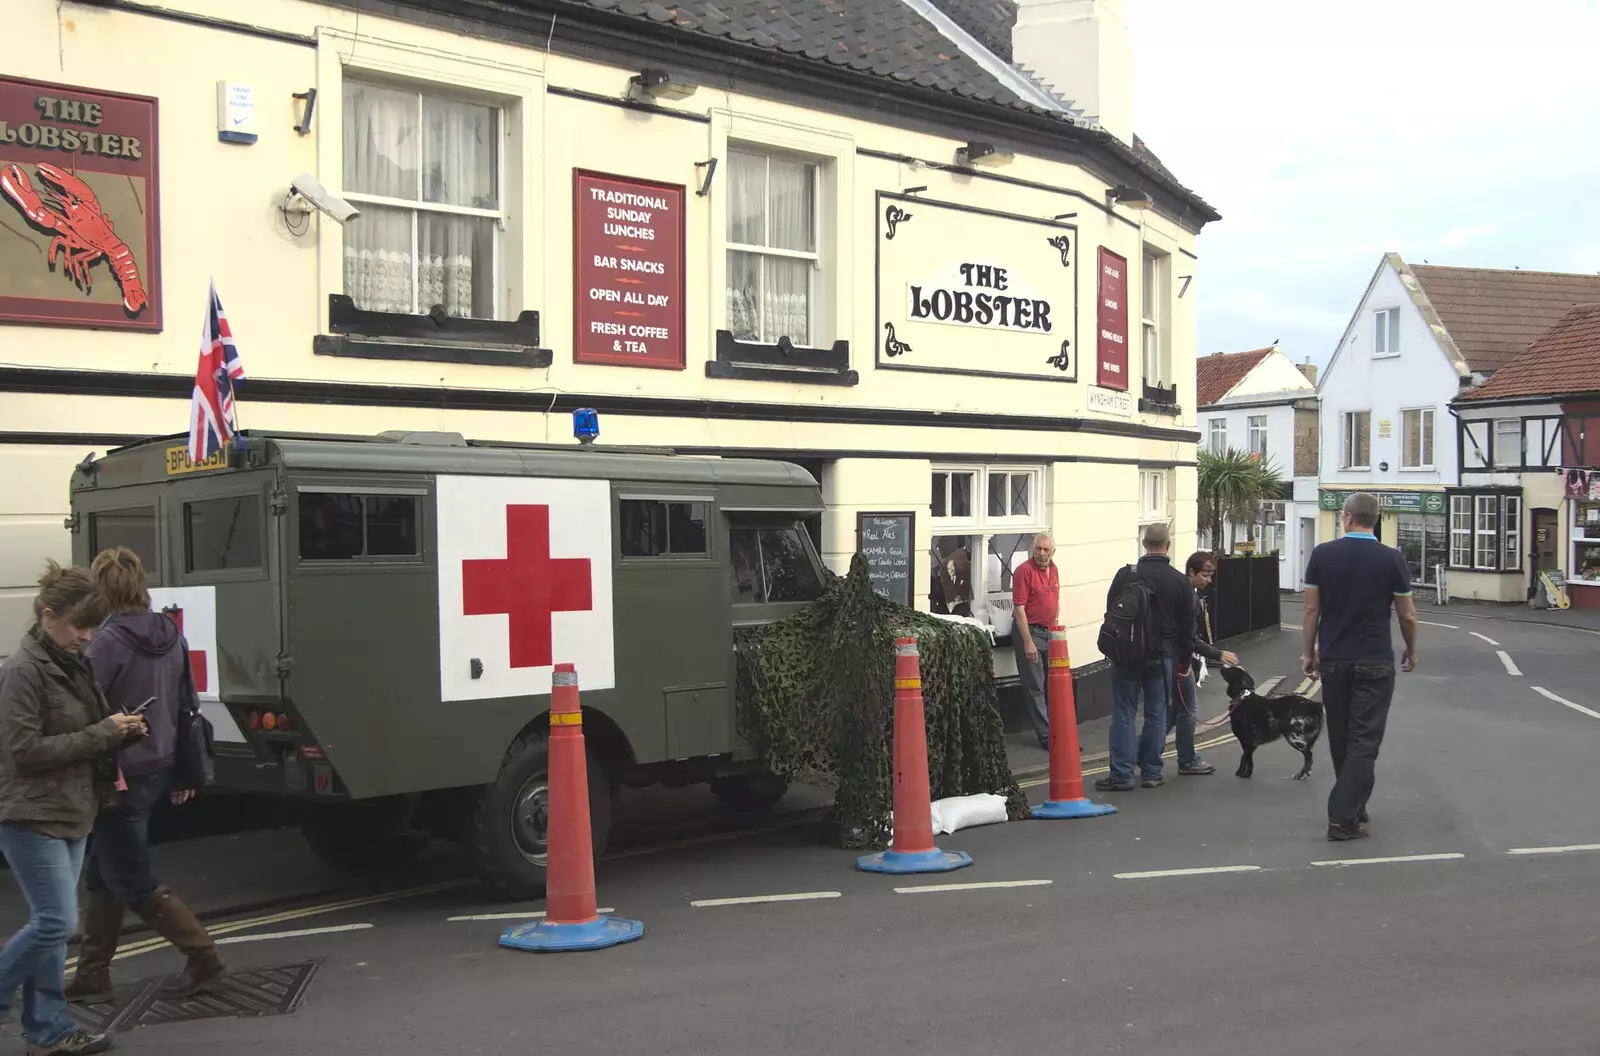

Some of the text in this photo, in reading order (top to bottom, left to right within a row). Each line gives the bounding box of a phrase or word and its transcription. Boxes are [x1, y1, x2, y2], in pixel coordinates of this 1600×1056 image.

[38, 96, 103, 125] THE
[0, 121, 143, 159] LOBSTER
[590, 188, 669, 210] TRADITIONAL
[607, 207, 652, 224] SUNDAY
[604, 223, 655, 240] LUNCHES
[594, 255, 665, 274] BAR SNACKS
[960, 263, 1008, 291] THE
[589, 288, 669, 307] OPEN ALL DAY
[910, 285, 1052, 332] LOBSTER
[591, 322, 669, 339] FRESH COFFEE
[612, 340, 648, 354] & TEA
[882, 528, 896, 540] Ales
